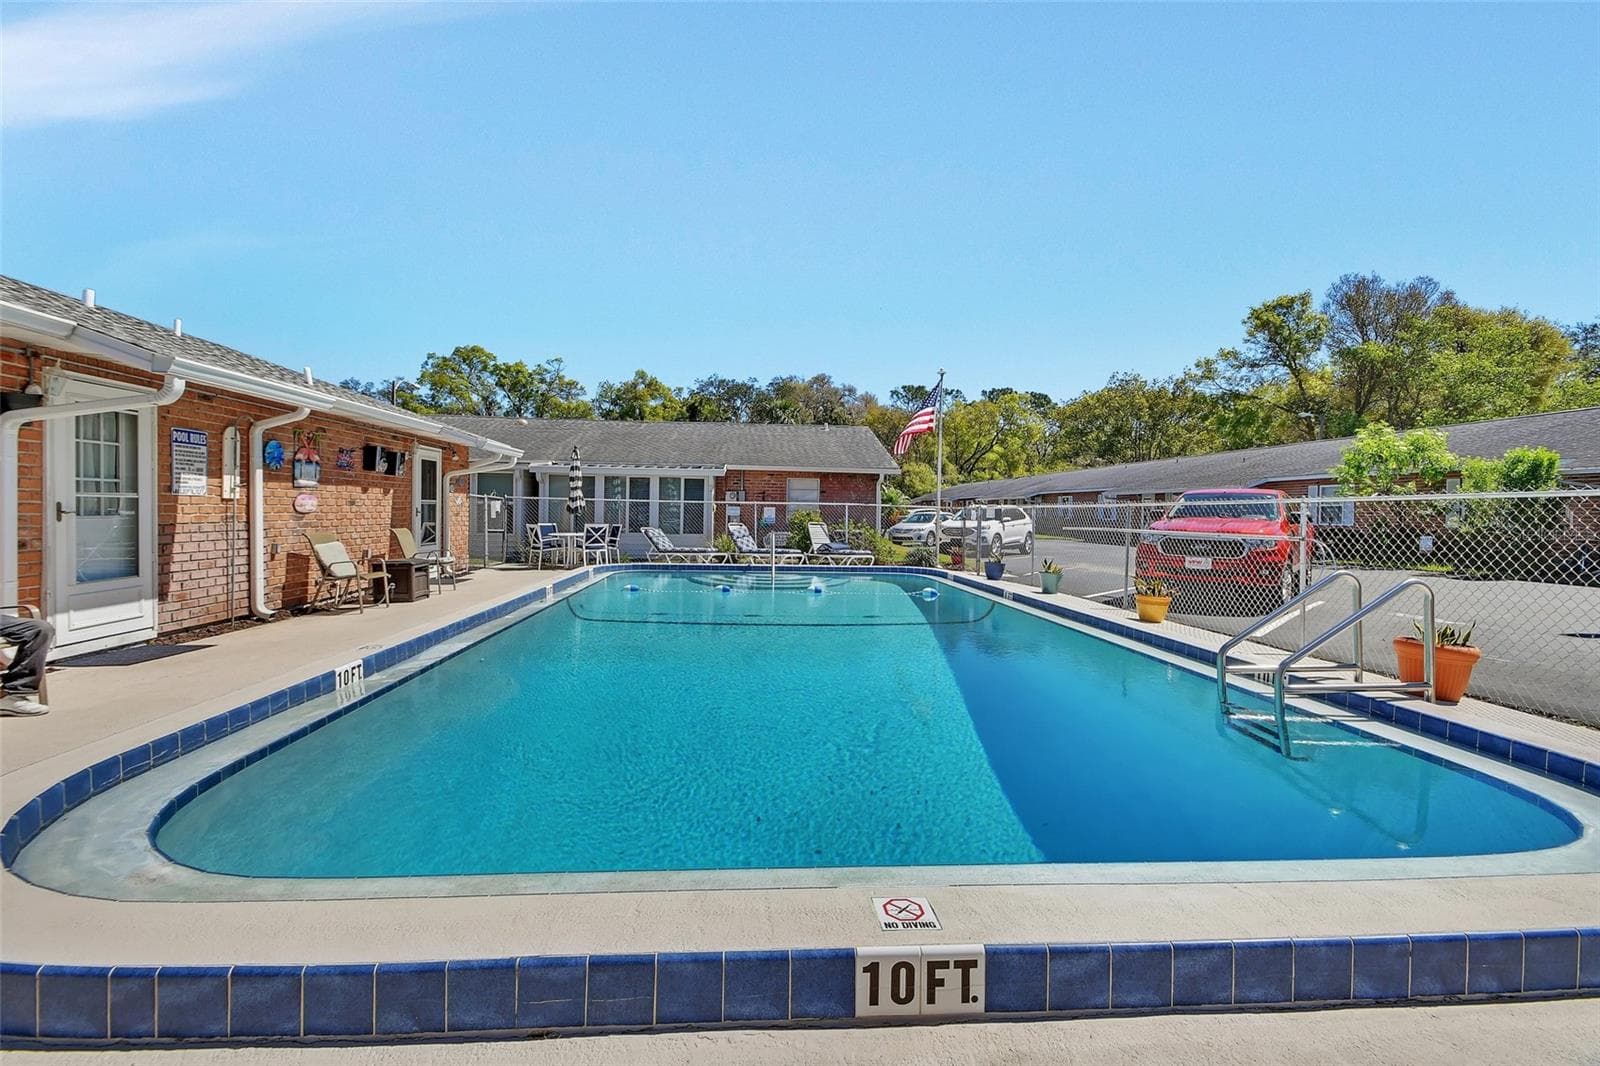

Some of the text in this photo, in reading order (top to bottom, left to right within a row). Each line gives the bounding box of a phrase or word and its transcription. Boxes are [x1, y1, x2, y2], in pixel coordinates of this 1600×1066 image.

[172, 430, 207, 445] POOL RULES
[902, 921, 937, 929] DIVING
[862, 959, 979, 1006] 10 FT.
